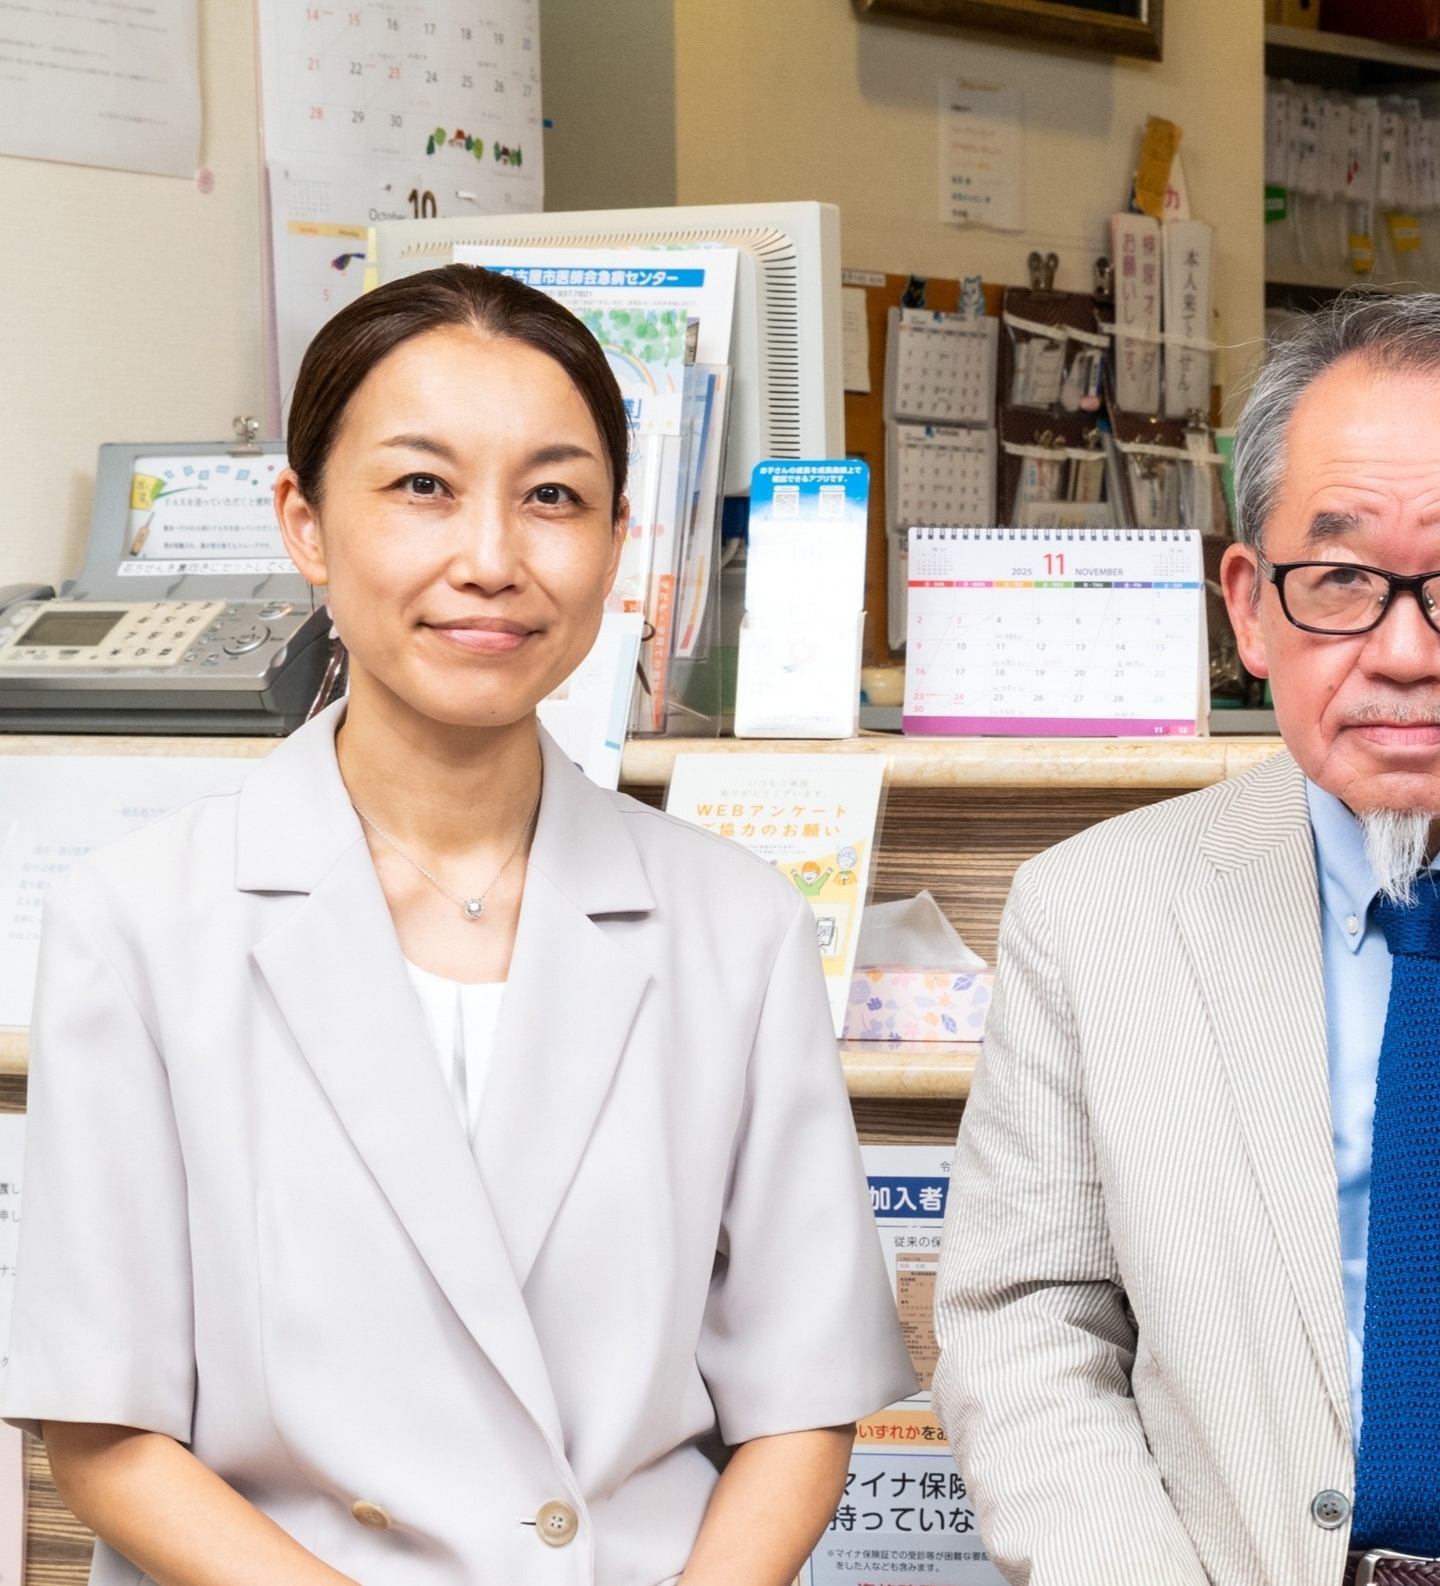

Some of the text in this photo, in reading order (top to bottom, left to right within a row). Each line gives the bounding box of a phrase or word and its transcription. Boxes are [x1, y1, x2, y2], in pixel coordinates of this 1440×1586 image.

[307, 9, 318, 21] 14
[387, 19, 399, 31] 16
[424, 23, 435, 35] 17
[461, 28, 472, 40] 18
[494, 33, 504, 45] 19
[307, 57, 532, 97] 21 22 23 24 25 26 27
[309, 107, 402, 127] 28 29 30
[408, 189, 437, 218] 10
[323, 289, 330, 301] 5
[1178, 249, 1199, 392] 本人来てせん
[1012, 554, 1124, 576] 2025 11 NOVEMBER
[916, 668, 1165, 677] 16 17 18 19 20 21 22
[914, 692, 1164, 702] 23 24 25 26 27 28 29
[913, 705, 924, 713] 30
[696, 803, 847, 819] WEBアンケート
[940, 1160, 952, 1174] 令
[868, 1186, 944, 1211] 加入者
[894, 1235, 942, 1248] 従来の保
[844, 1472, 966, 1499] マイナ保険
[829, 1505, 975, 1533] 持っていな
[836, 1562, 940, 1573] をした人なども含みます。
